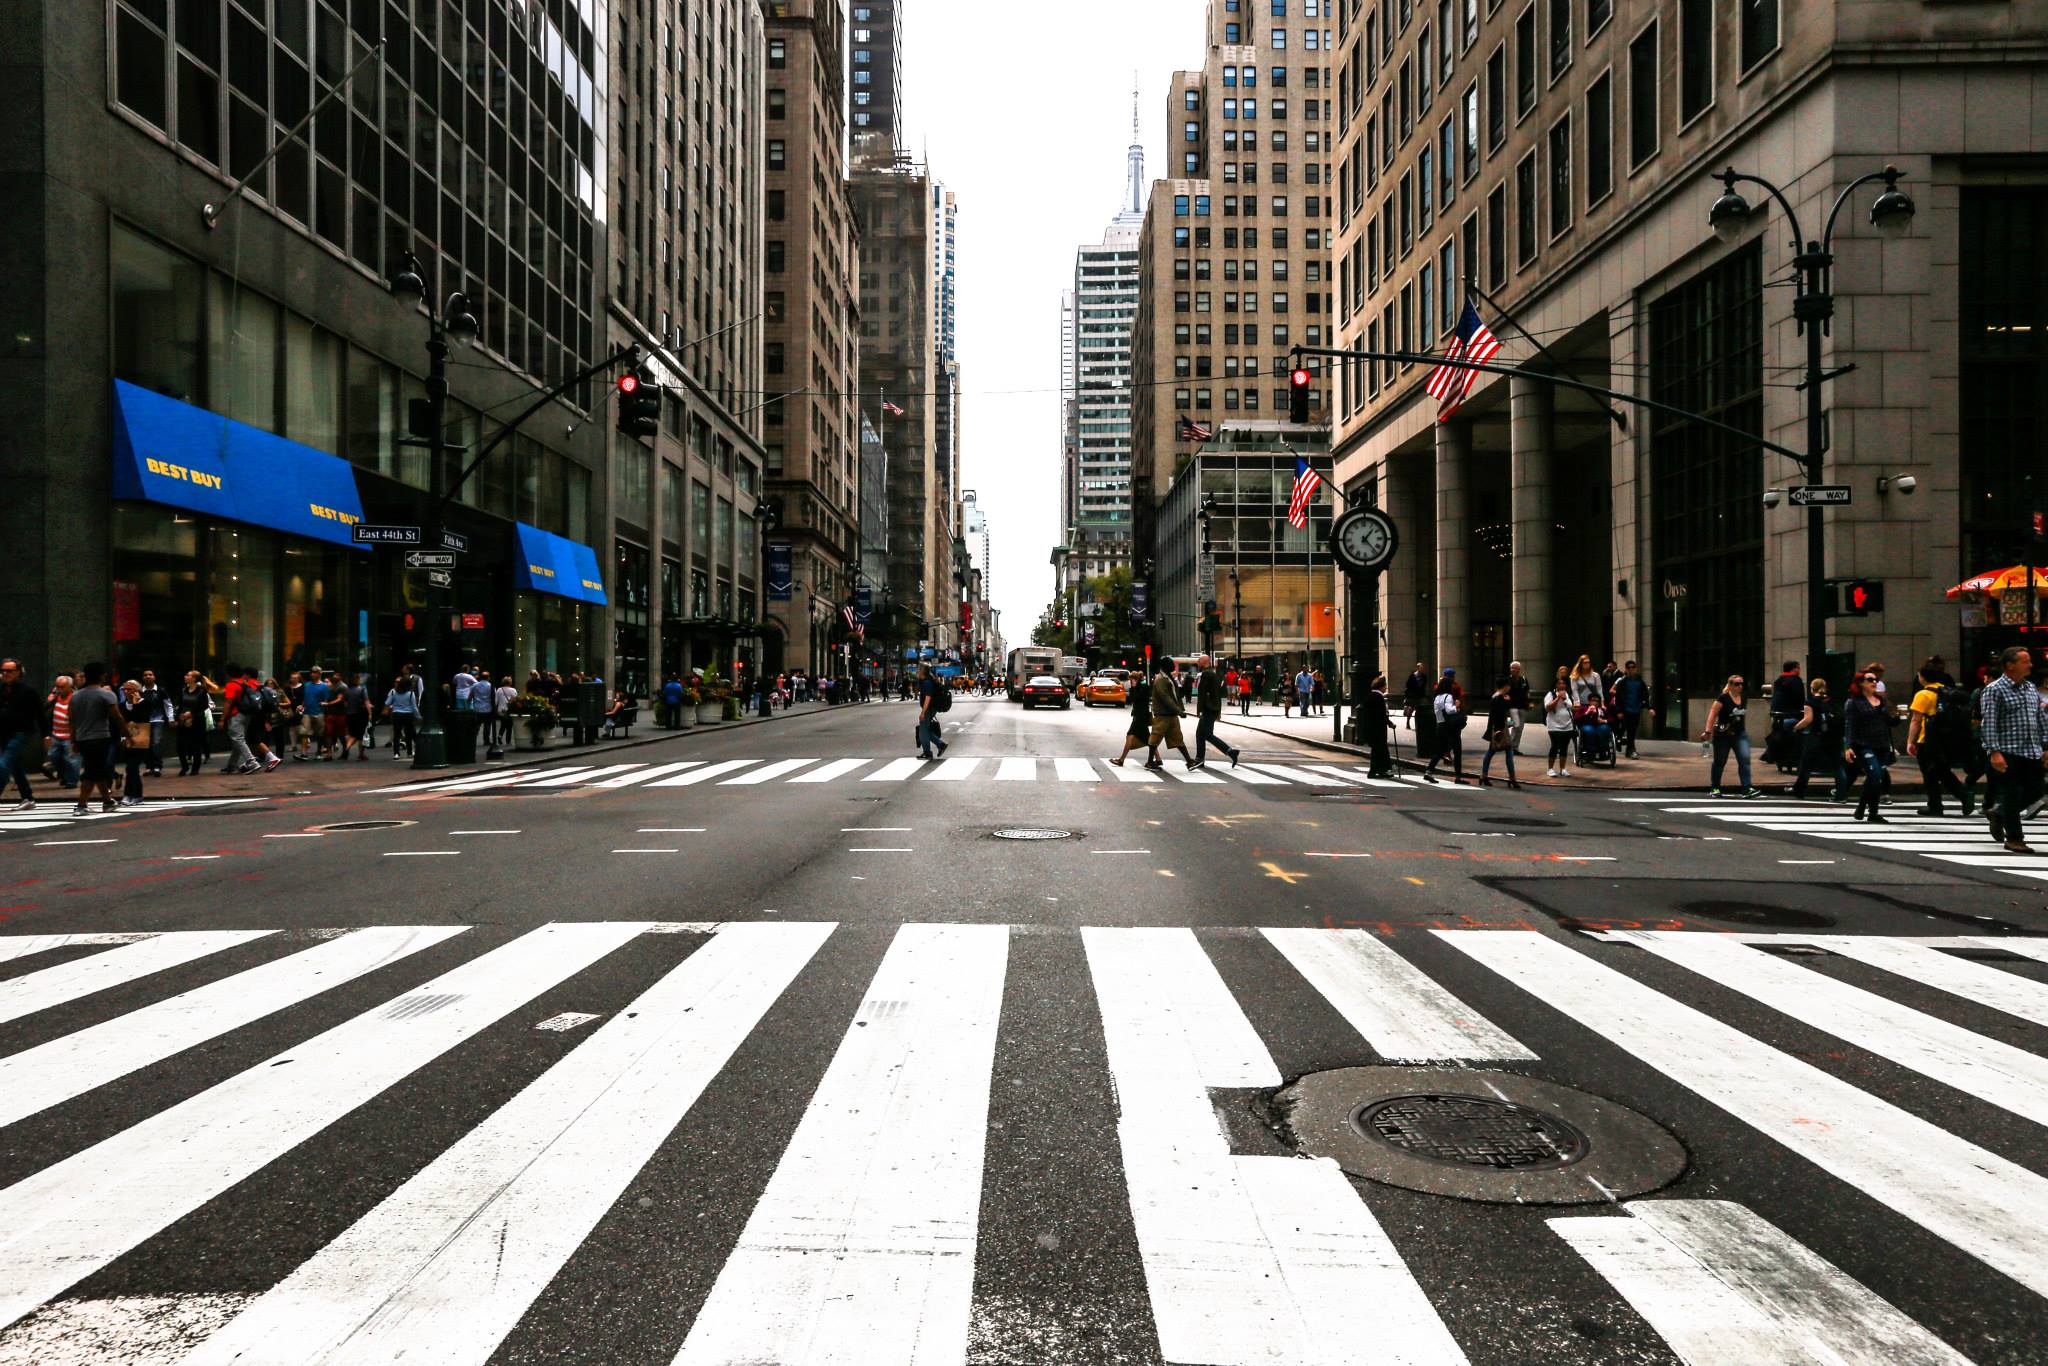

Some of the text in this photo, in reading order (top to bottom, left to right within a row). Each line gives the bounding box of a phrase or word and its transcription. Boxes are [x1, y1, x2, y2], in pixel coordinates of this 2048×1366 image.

[146, 457, 222, 490] BEST BUY
[1795, 491, 1846, 500] ONE WAY
[310, 503, 360, 525] BEST BUY
[358, 528, 416, 540] East 44th St
